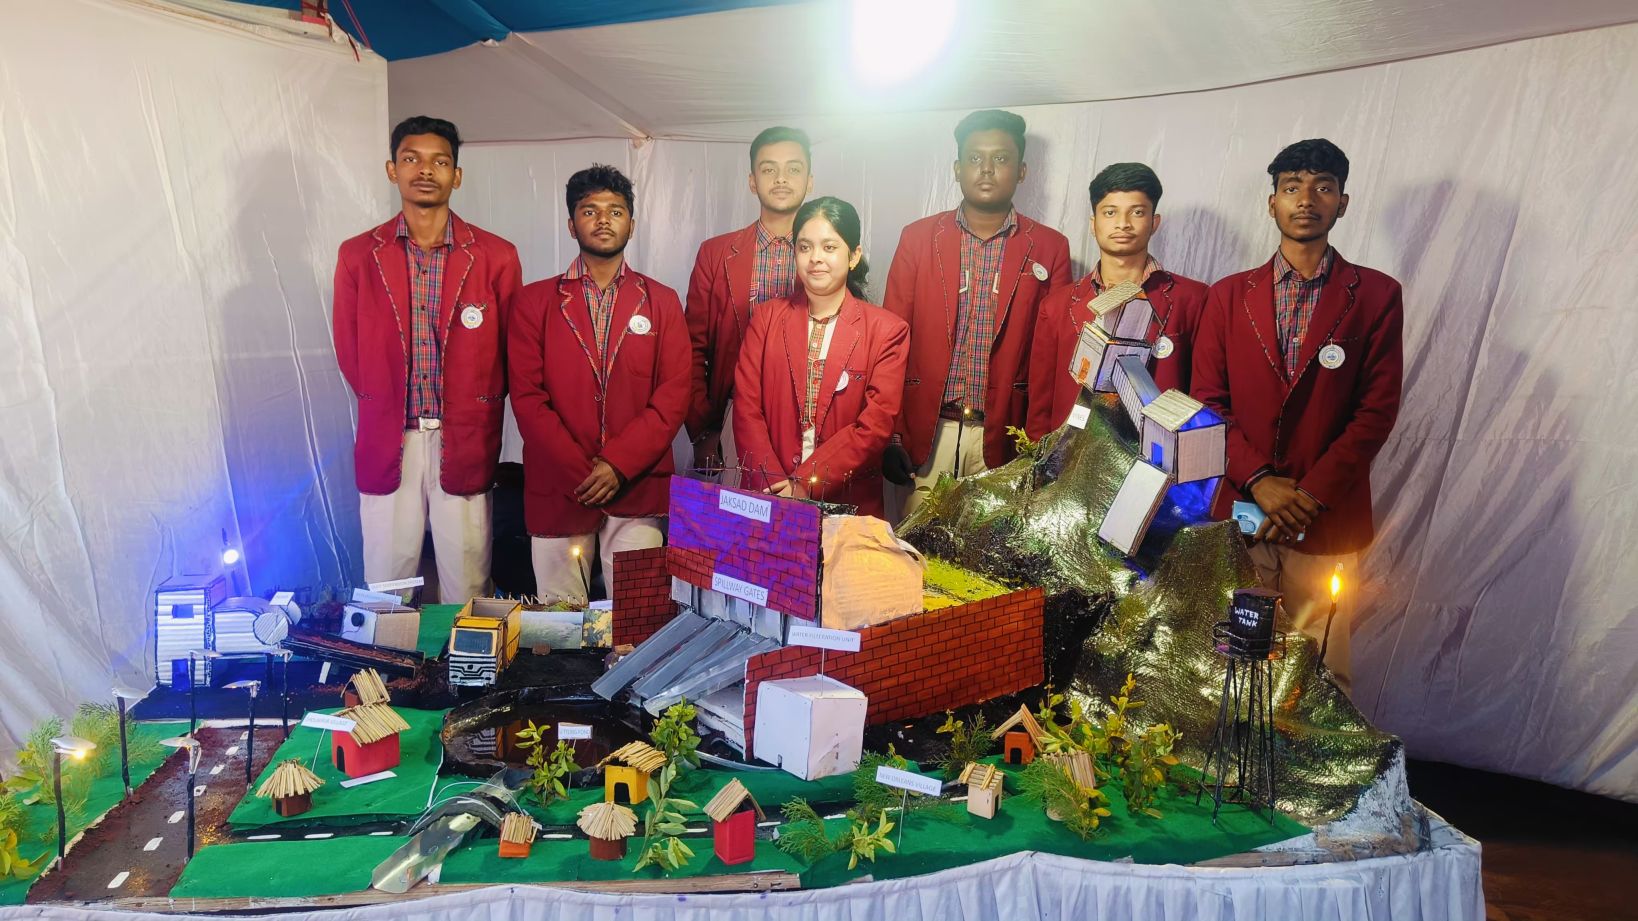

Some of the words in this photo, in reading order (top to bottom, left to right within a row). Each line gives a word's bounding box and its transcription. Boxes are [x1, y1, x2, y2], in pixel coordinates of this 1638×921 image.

[720, 495, 747, 511] JAKSAD
[748, 502, 768, 517] DAM
[714, 576, 742, 593] SPILLWAY
[743, 586, 765, 601] GATES
[1234, 606, 1259, 620] WATER
[1238, 616, 1258, 628] TANK
